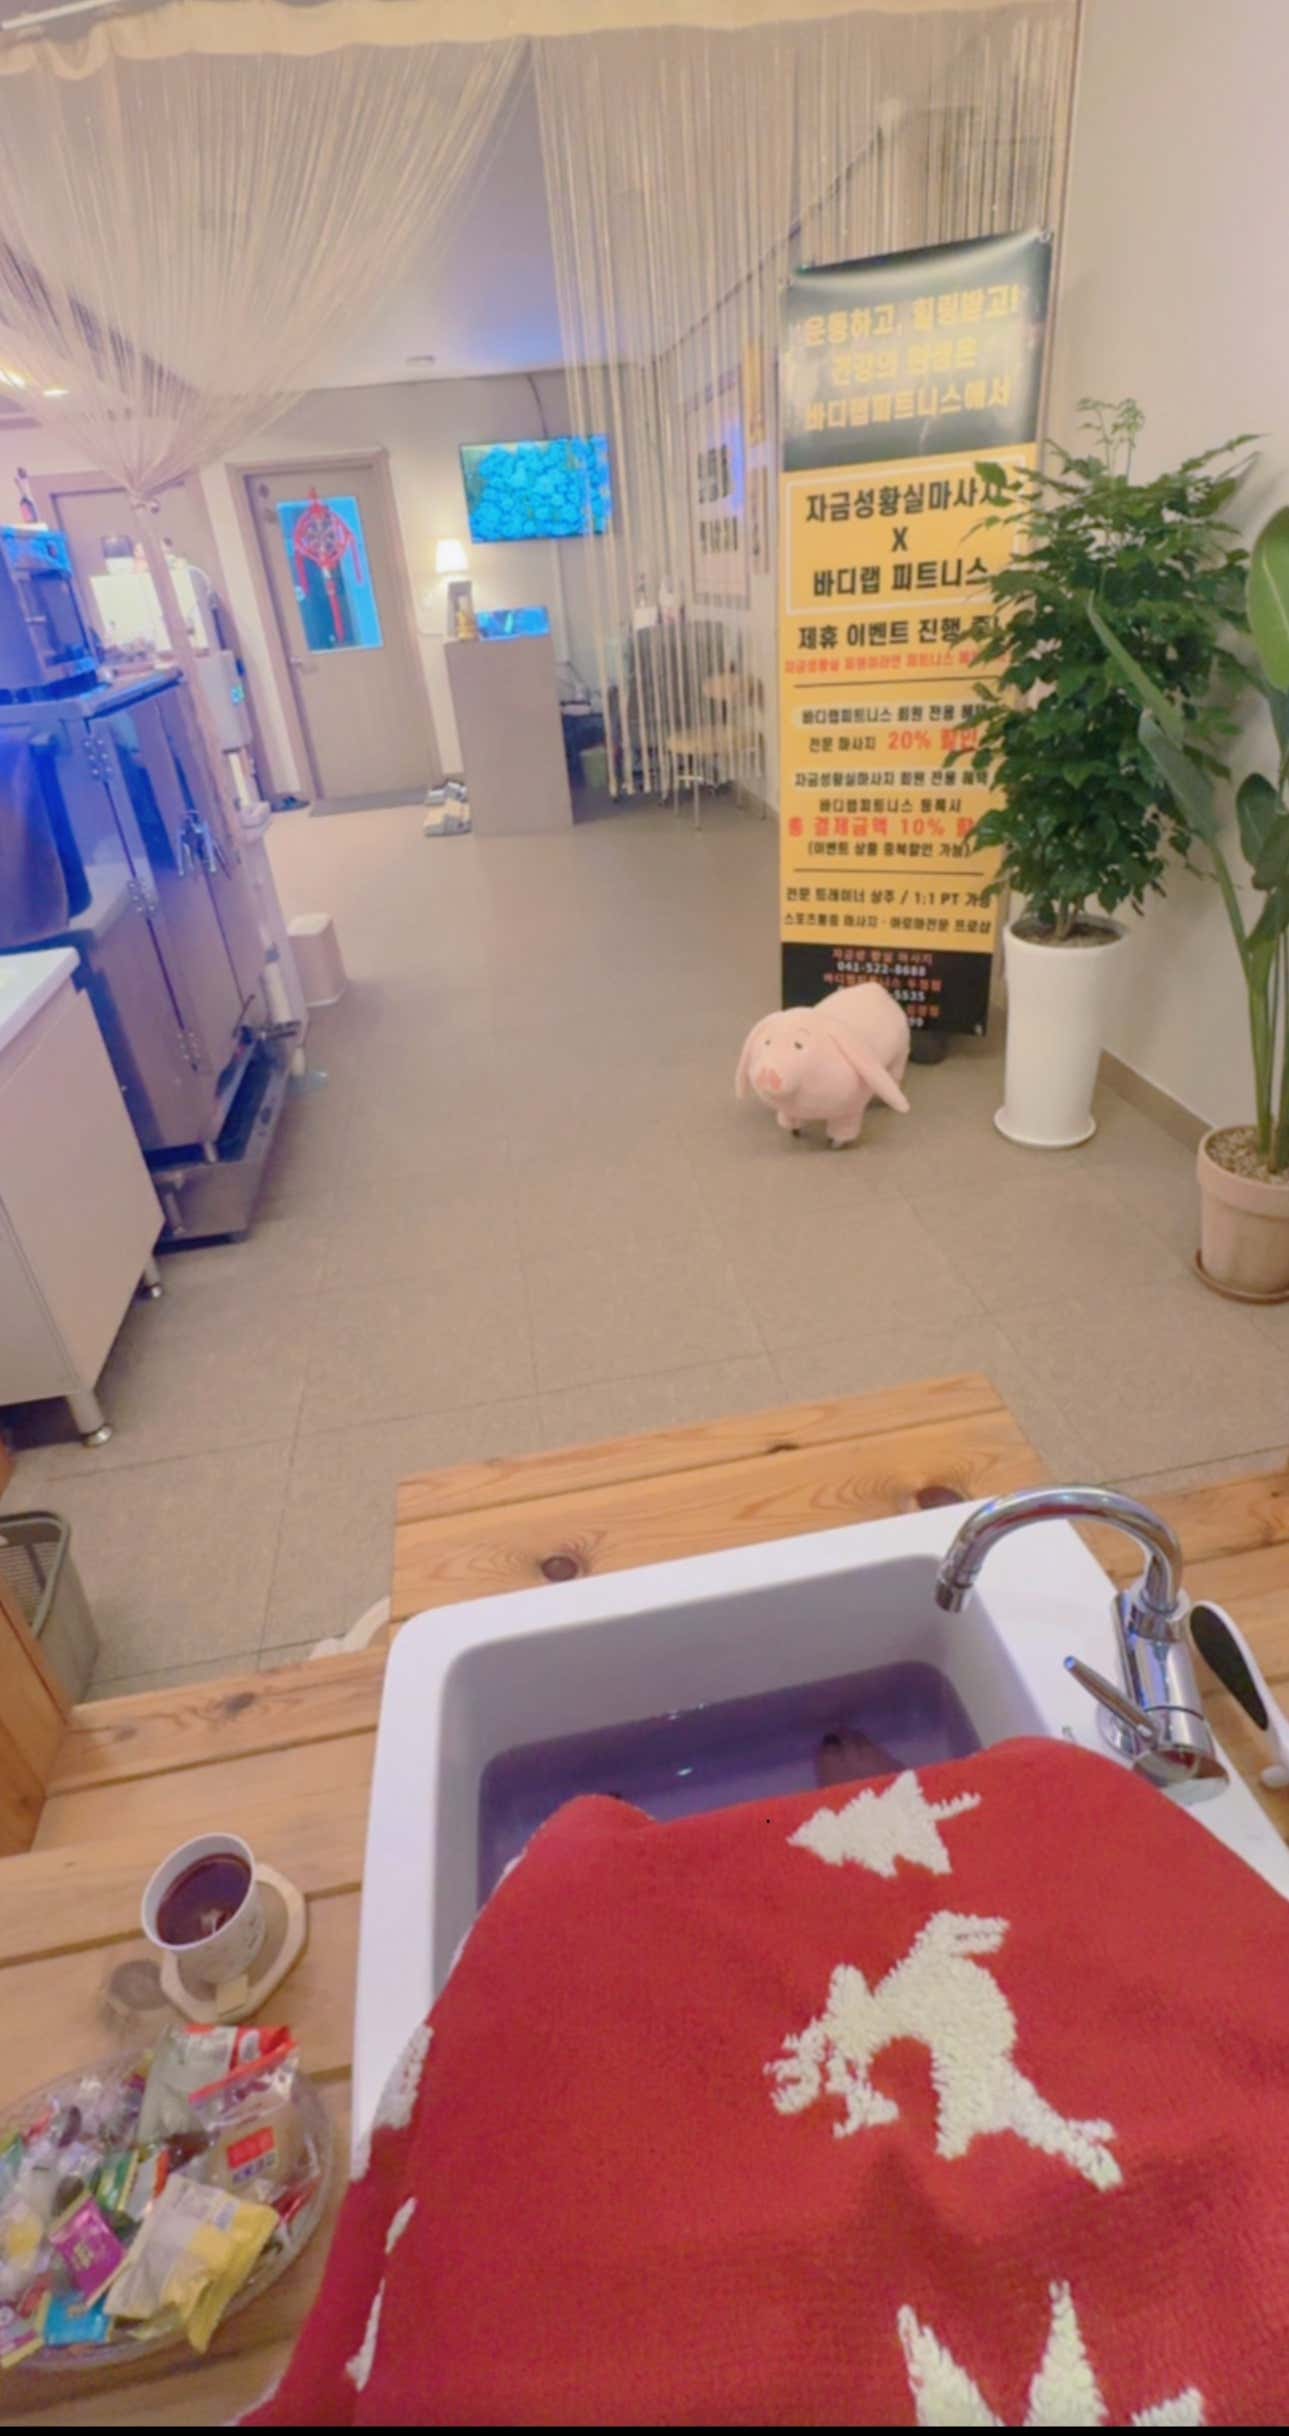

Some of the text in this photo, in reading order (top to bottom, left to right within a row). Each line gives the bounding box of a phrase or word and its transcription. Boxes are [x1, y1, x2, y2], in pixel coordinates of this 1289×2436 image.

[804, 376, 1012, 432] 바디랩피트니스에서
[891, 526, 909, 553] X
[813, 556, 990, 597] 바디랩 피트니스
[798, 625, 838, 650] 제휴
[846, 620, 910, 647] 이벤트
[918, 616, 961, 645] 진행
[803, 707, 892, 725] 바디랩피트니스
[898, 705, 922, 721] 회원
[929, 704, 955, 721] 전용
[809, 737, 833, 753] 전문
[839, 735, 876, 752] 마사지
[888, 730, 931, 750] 20%
[795, 772, 895, 788] 자금성황실마사지
[901, 771, 925, 787] 회원
[931, 770, 956, 787] 전용
[820, 797, 962, 813] 바디랩피트니스 등록시
[815, 816, 888, 838] 결제금액
[902, 817, 946, 837] 10%
[808, 841, 849, 856] (이벤트
[787, 887, 810, 902] 전문
[816, 888, 865, 904] 트레이너
[871, 889, 895, 905] 상주
[914, 891, 935, 906] 1:1
[940, 892, 959, 907] PT
[844, 914, 878, 929] 마사지
